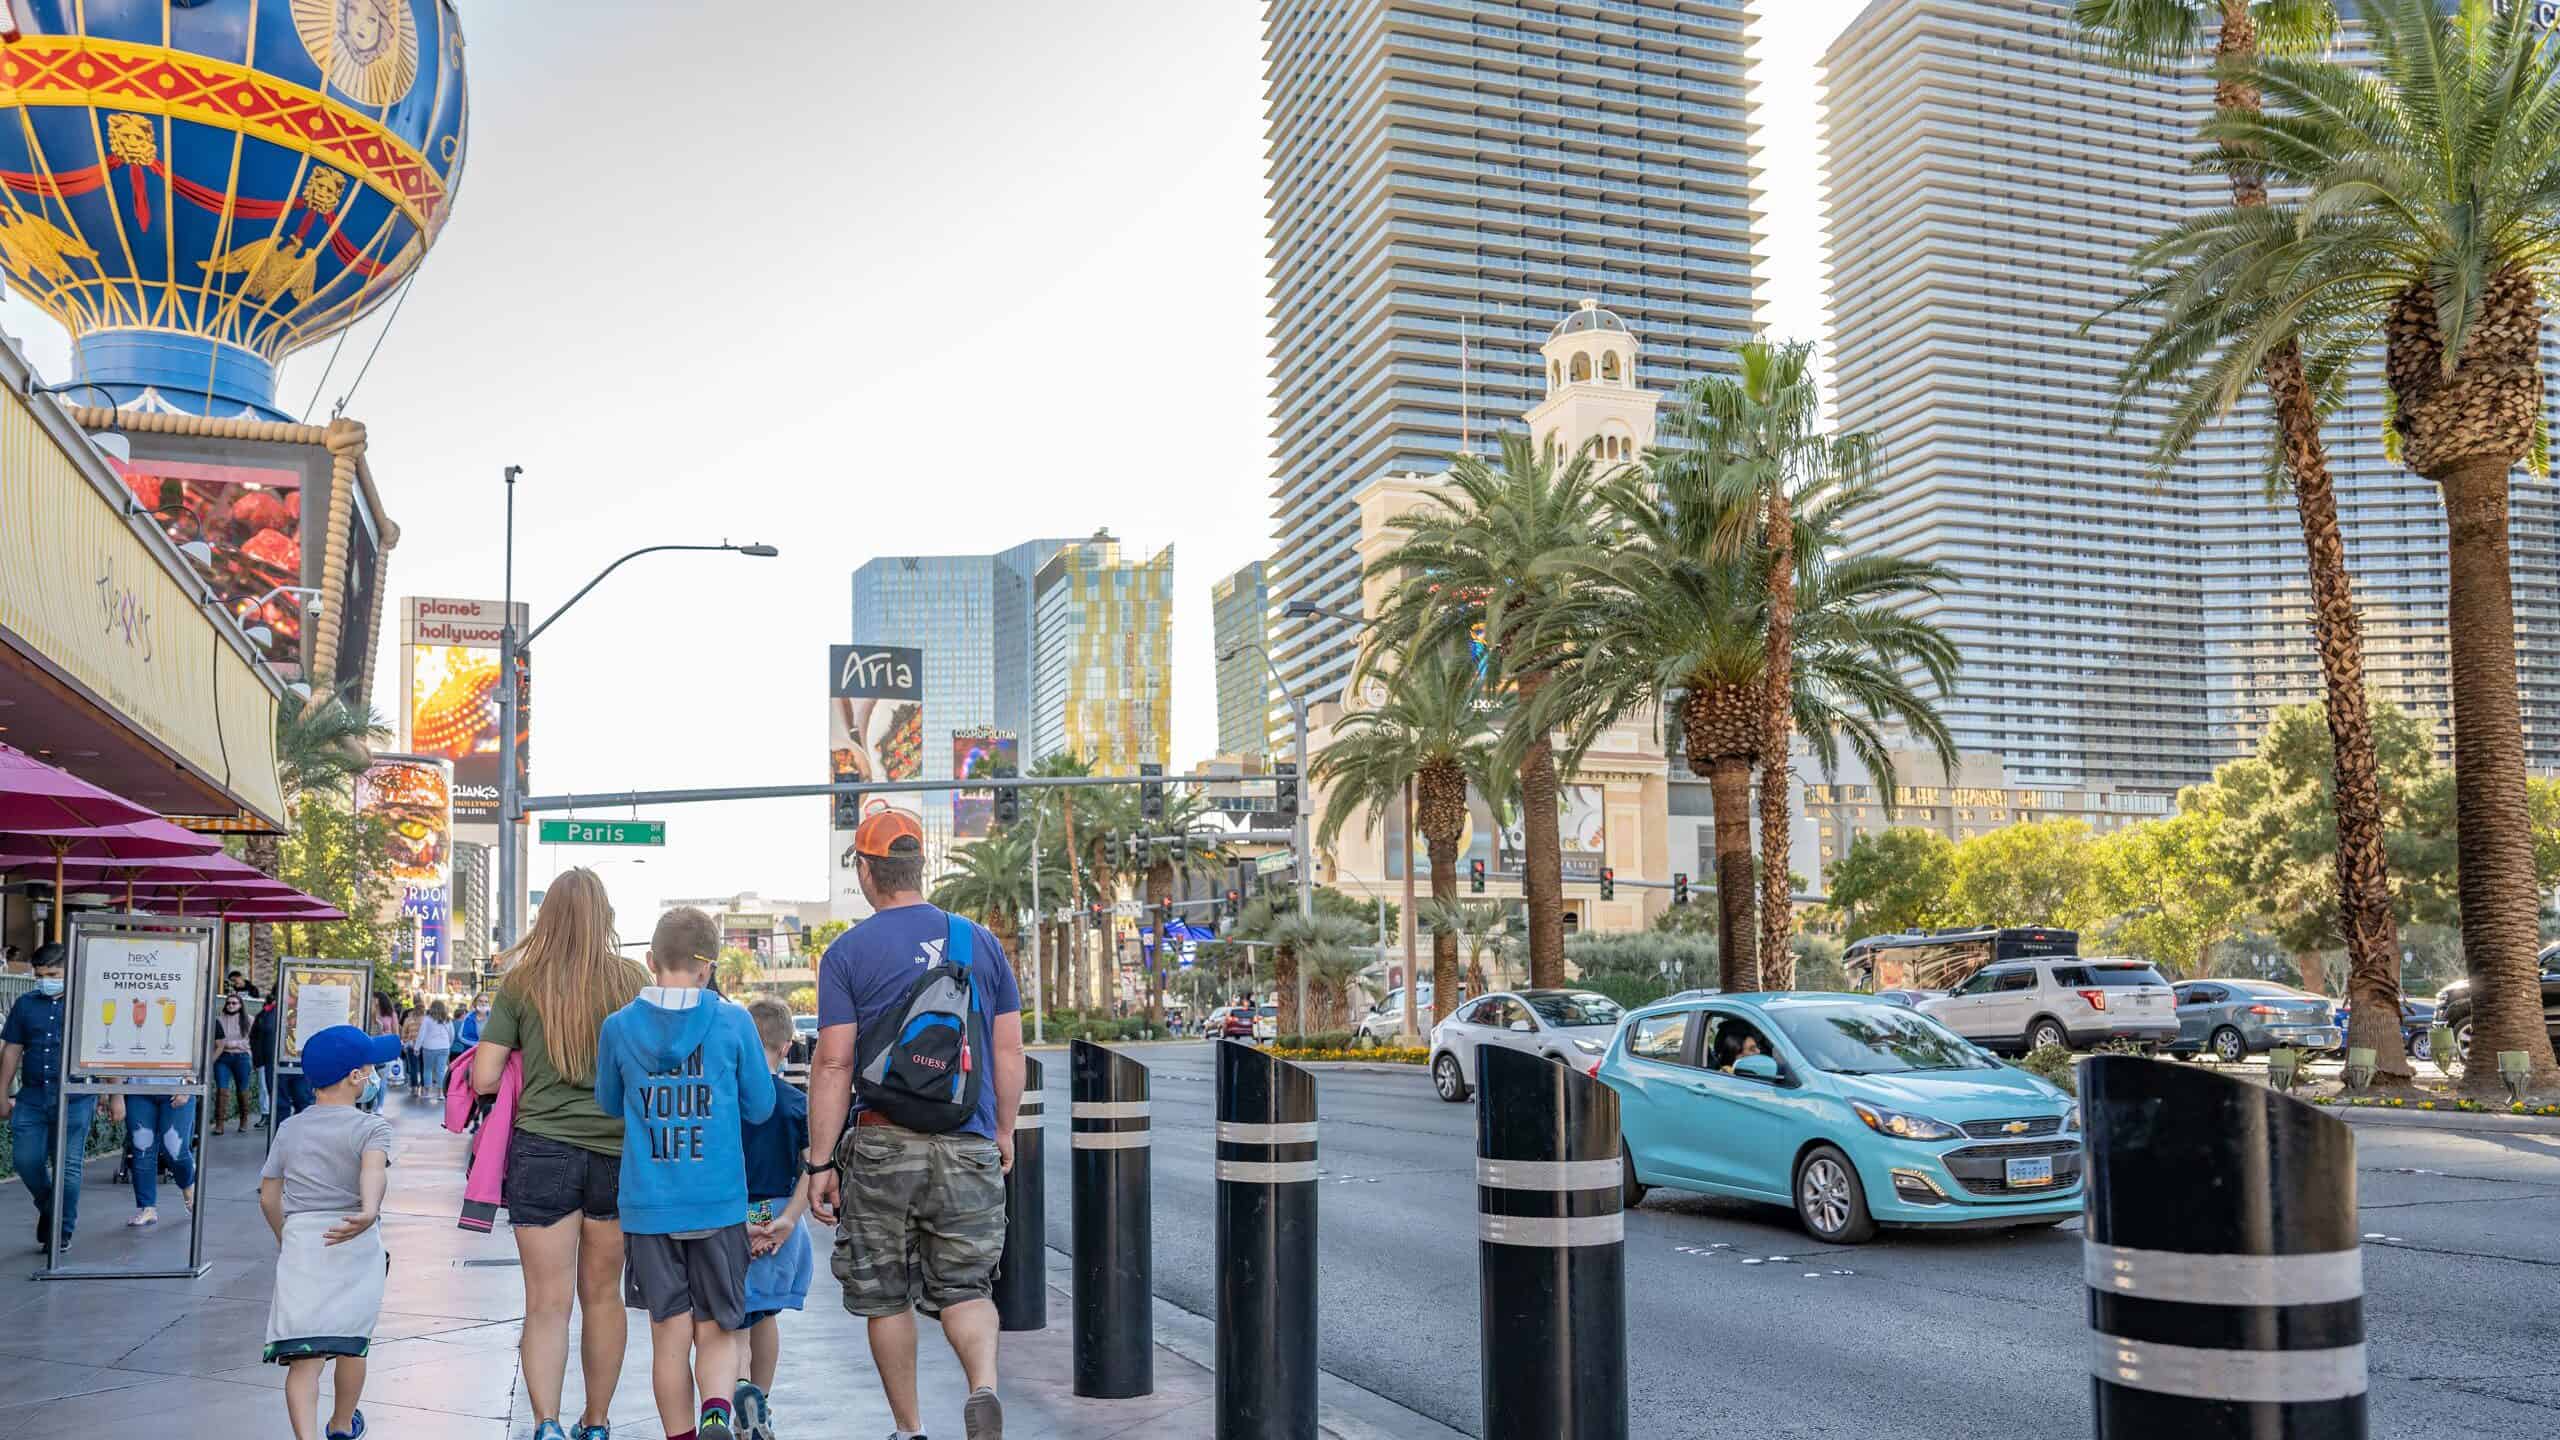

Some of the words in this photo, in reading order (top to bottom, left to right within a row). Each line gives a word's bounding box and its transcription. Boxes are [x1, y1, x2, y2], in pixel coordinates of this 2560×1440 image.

[420, 599, 480, 618] planet
[420, 622, 502, 643] hollywoo
[841, 651, 912, 689] Aria
[568, 823, 625, 841] Paris
[104, 971, 182, 981] BOTTOMLESS
[114, 981, 169, 990] MIMOSAS
[912, 1054, 947, 1071] GUESS
[639, 1084, 713, 1120] YOUR
[649, 1126, 704, 1160] LIFE
